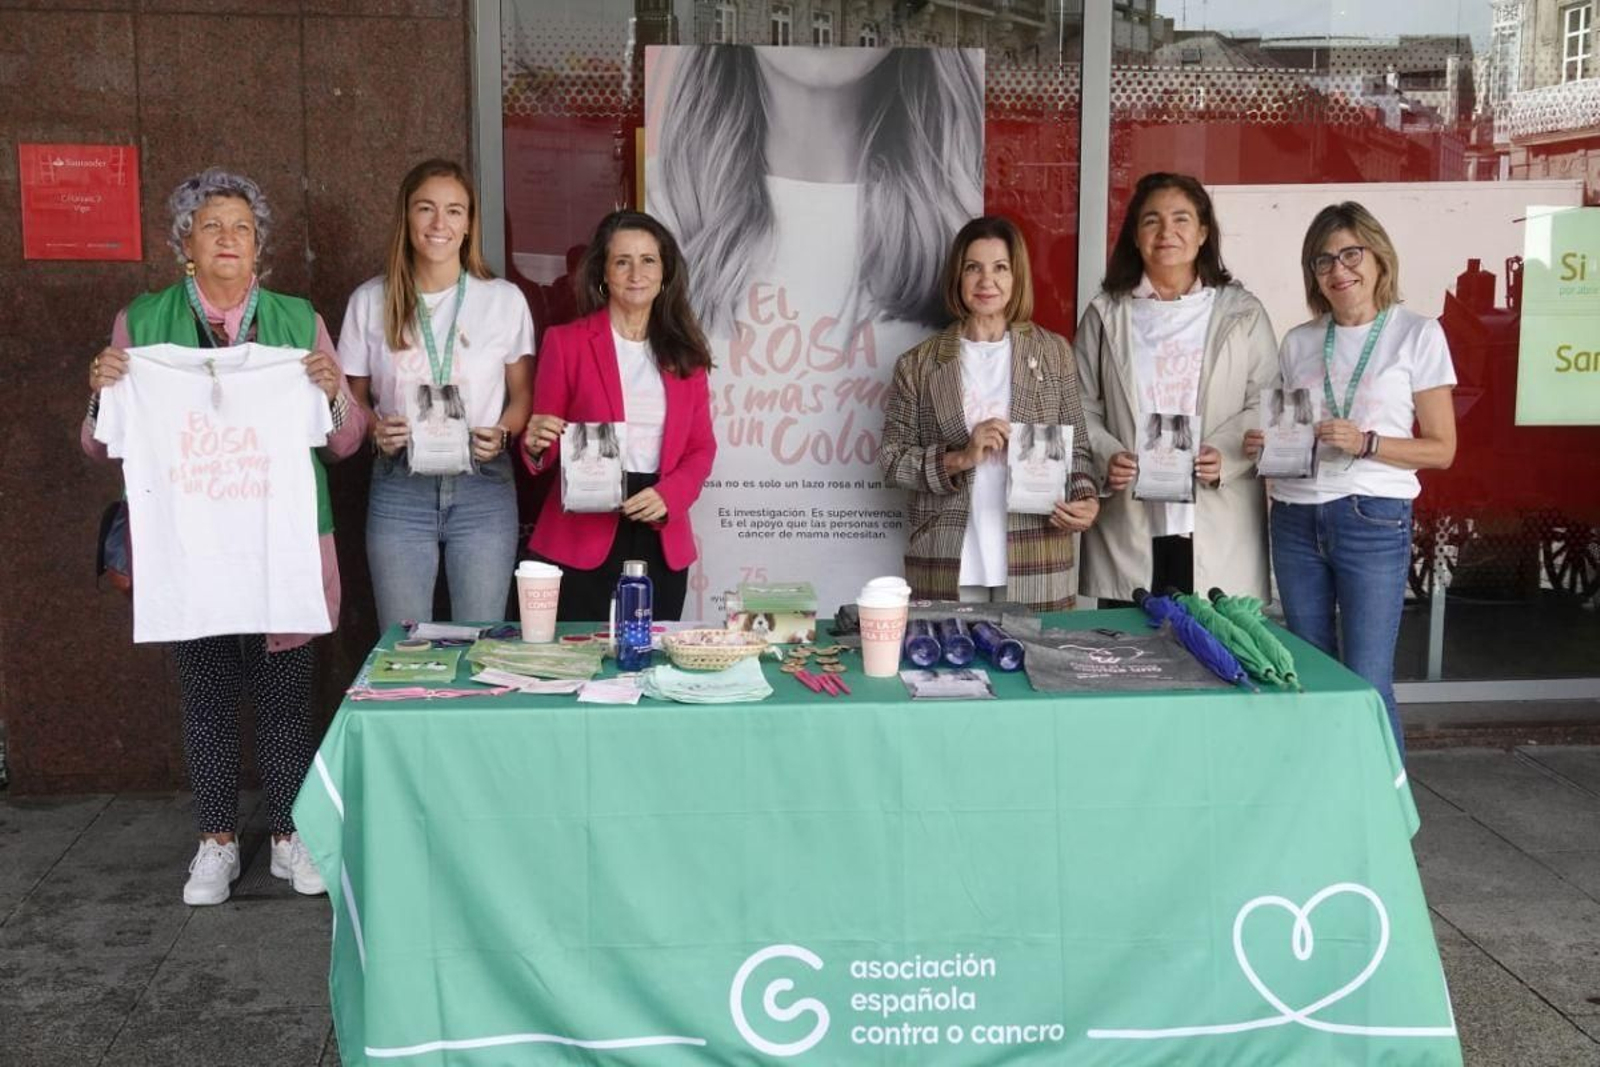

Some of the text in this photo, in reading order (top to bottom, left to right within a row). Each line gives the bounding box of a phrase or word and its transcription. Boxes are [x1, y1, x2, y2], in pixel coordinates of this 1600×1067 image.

[1560, 252, 1586, 281] Si
[729, 315, 878, 378] ROSA
[743, 370, 826, 416] más
[181, 427, 258, 459] ROSA
[771, 409, 881, 466] Colo
[702, 481, 721, 489] osa
[725, 481, 739, 489] no
[742, 481, 755, 489] es
[759, 480, 781, 489] solo
[785, 481, 798, 489] un
[802, 480, 825, 489] lazo
[828, 481, 850, 489] rosa
[868, 481, 881, 489] un
[718, 508, 730, 517] Es
[811, 508, 825, 518] Es
[720, 519, 902, 530] Es el apoyo que las personas con
[738, 528, 775, 539] cáncer
[779, 529, 792, 539] de
[796, 531, 830, 539] mama
[739, 566, 766, 585] 75
[851, 953, 996, 979] asociación
[851, 986, 976, 1017] española
[851, 1022, 1065, 1046] contra o cancro
